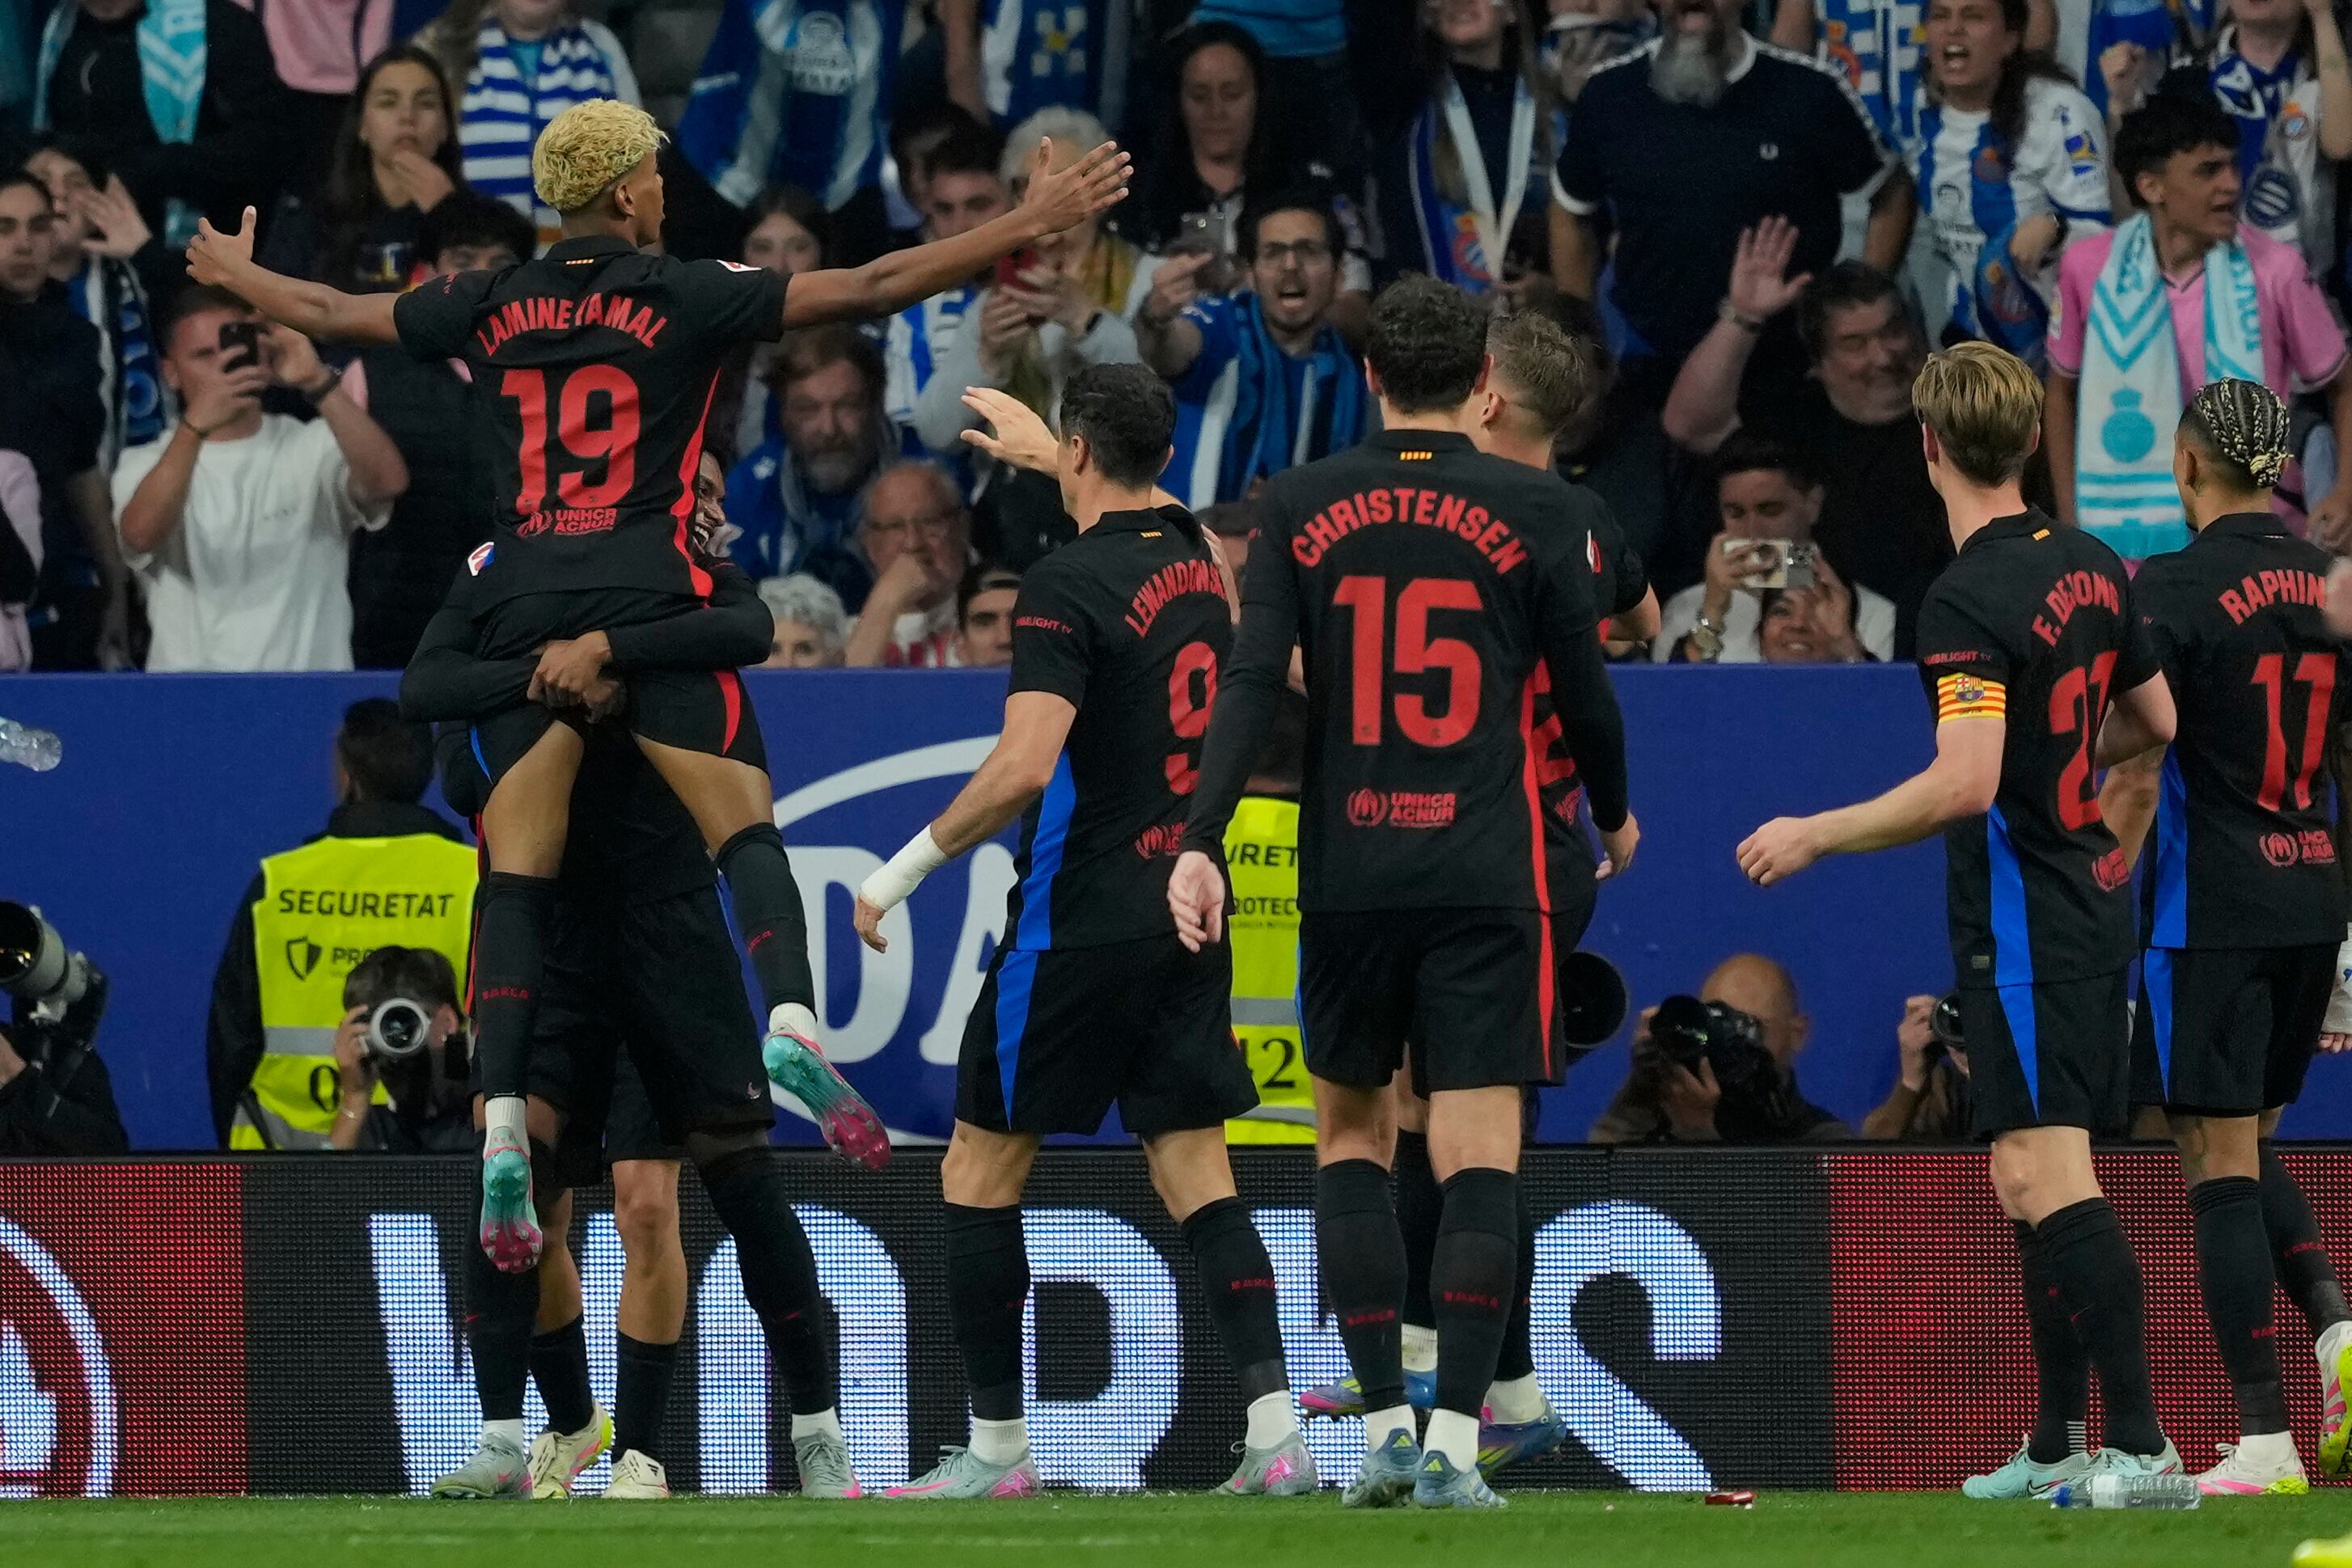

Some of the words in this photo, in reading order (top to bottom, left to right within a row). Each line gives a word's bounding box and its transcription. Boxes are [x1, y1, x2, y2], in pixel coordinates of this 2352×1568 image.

[476, 297, 573, 357] LAMINE
[500, 363, 641, 515] 19
[1290, 487, 1528, 574] CHRISTENSEN
[1165, 641, 1217, 796] 9
[1333, 575, 1483, 747] 15
[2251, 653, 2337, 812] 11
[1390, 791, 1456, 807] UNHCR
[278, 889, 454, 917] SEGURETAT
